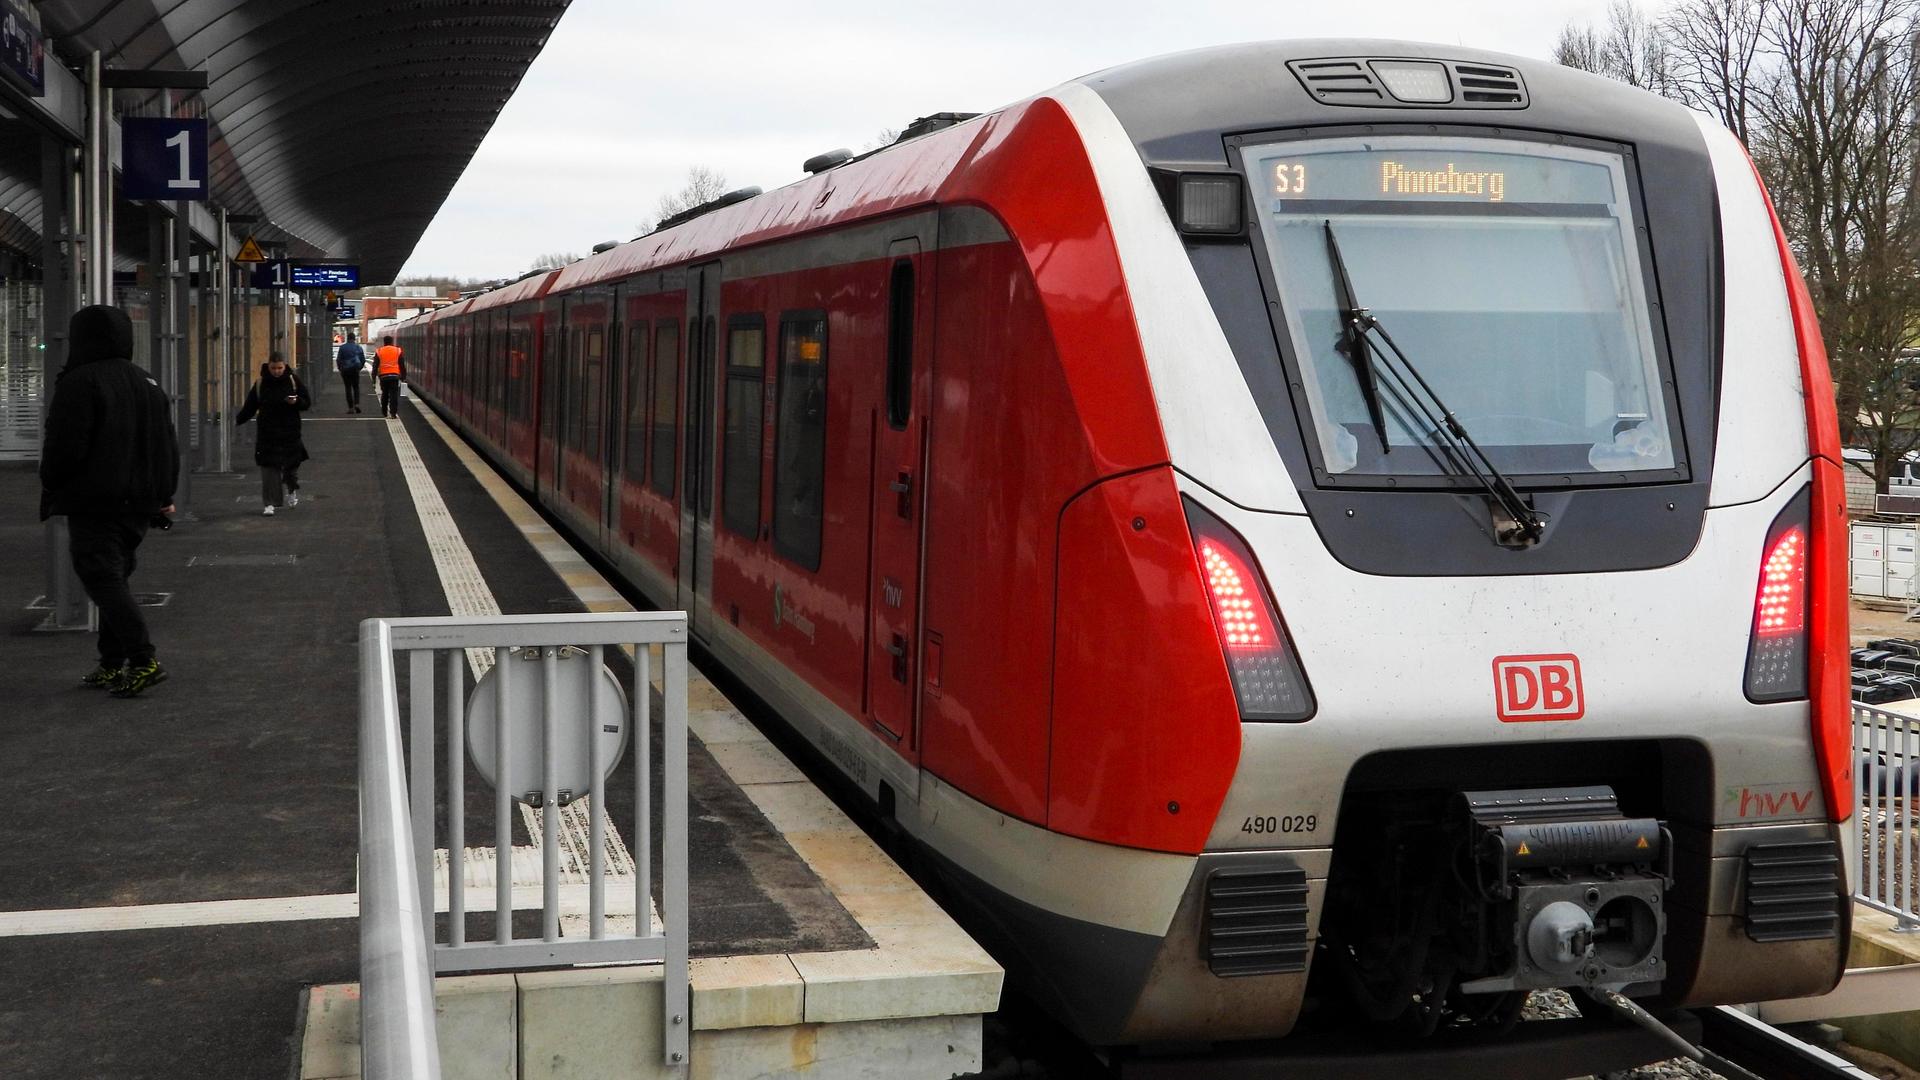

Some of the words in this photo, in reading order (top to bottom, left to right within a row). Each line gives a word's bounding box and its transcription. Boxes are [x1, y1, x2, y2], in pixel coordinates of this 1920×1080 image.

[166, 130, 200, 188] 1
[1276, 163, 1305, 193] S3
[1381, 160, 1505, 201] Pinneberg
[271, 263, 285, 286] 1
[1506, 664, 1574, 710] DB
[1738, 787, 1814, 817] hvv
[1241, 816, 1277, 834] 490
[1282, 815, 1317, 833] 029
